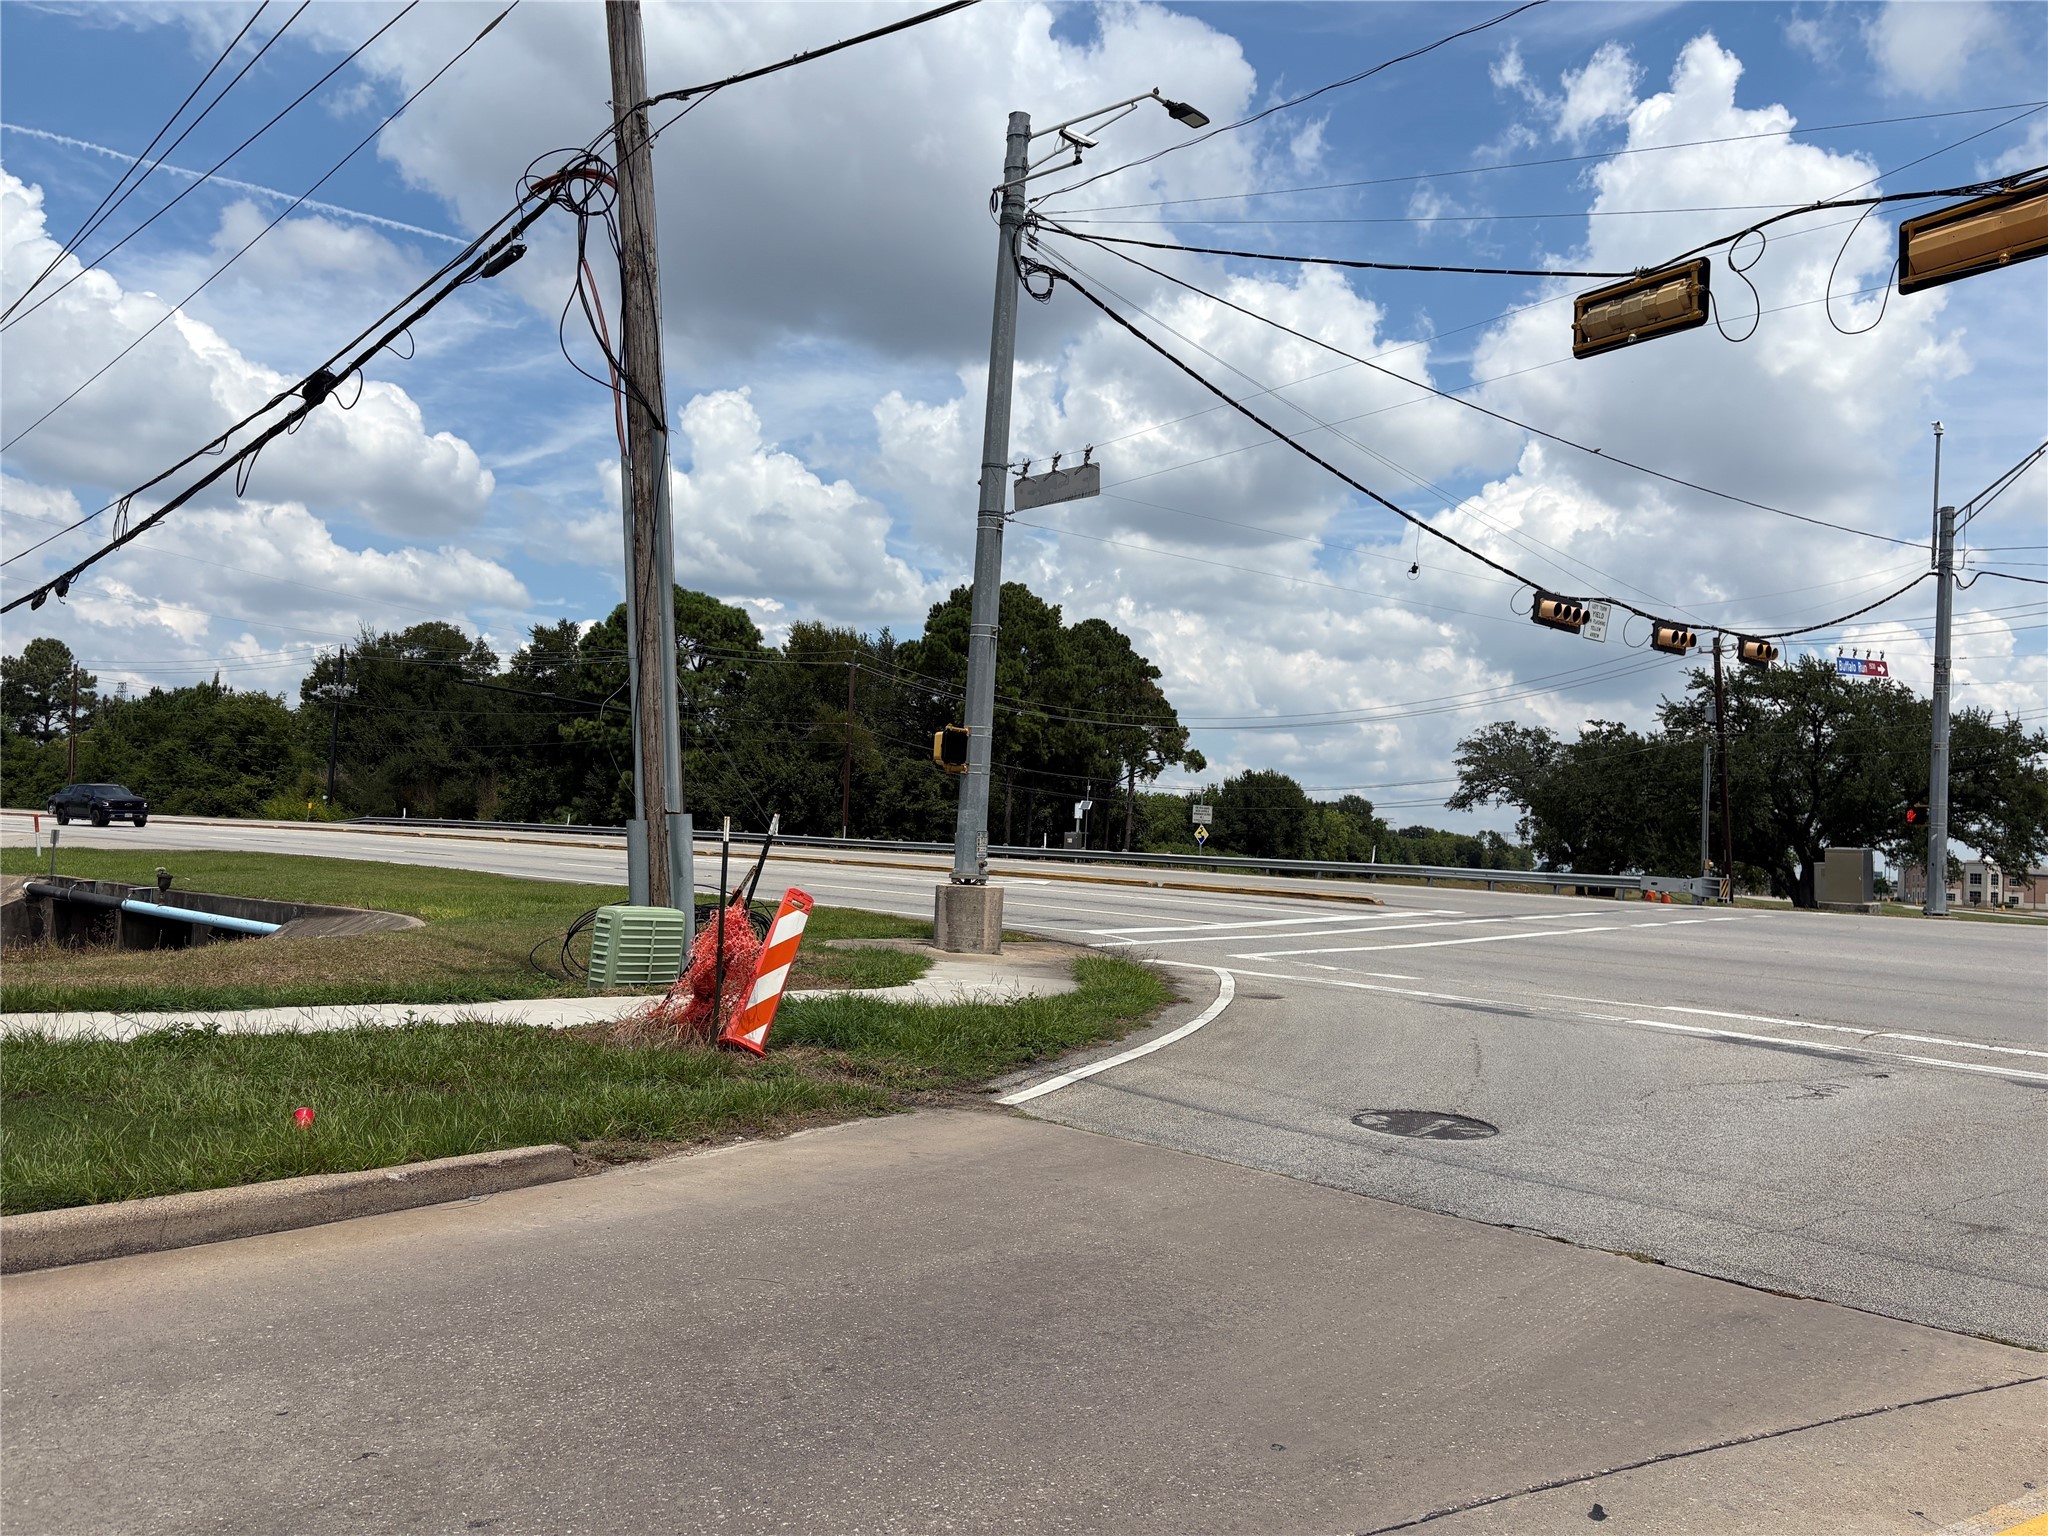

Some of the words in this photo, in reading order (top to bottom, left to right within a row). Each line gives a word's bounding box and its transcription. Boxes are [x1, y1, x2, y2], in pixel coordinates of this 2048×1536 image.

[1592, 610, 1604, 620] YIELD
[1838, 660, 1856, 672] Buffalo
[1858, 662, 1868, 673] Run
